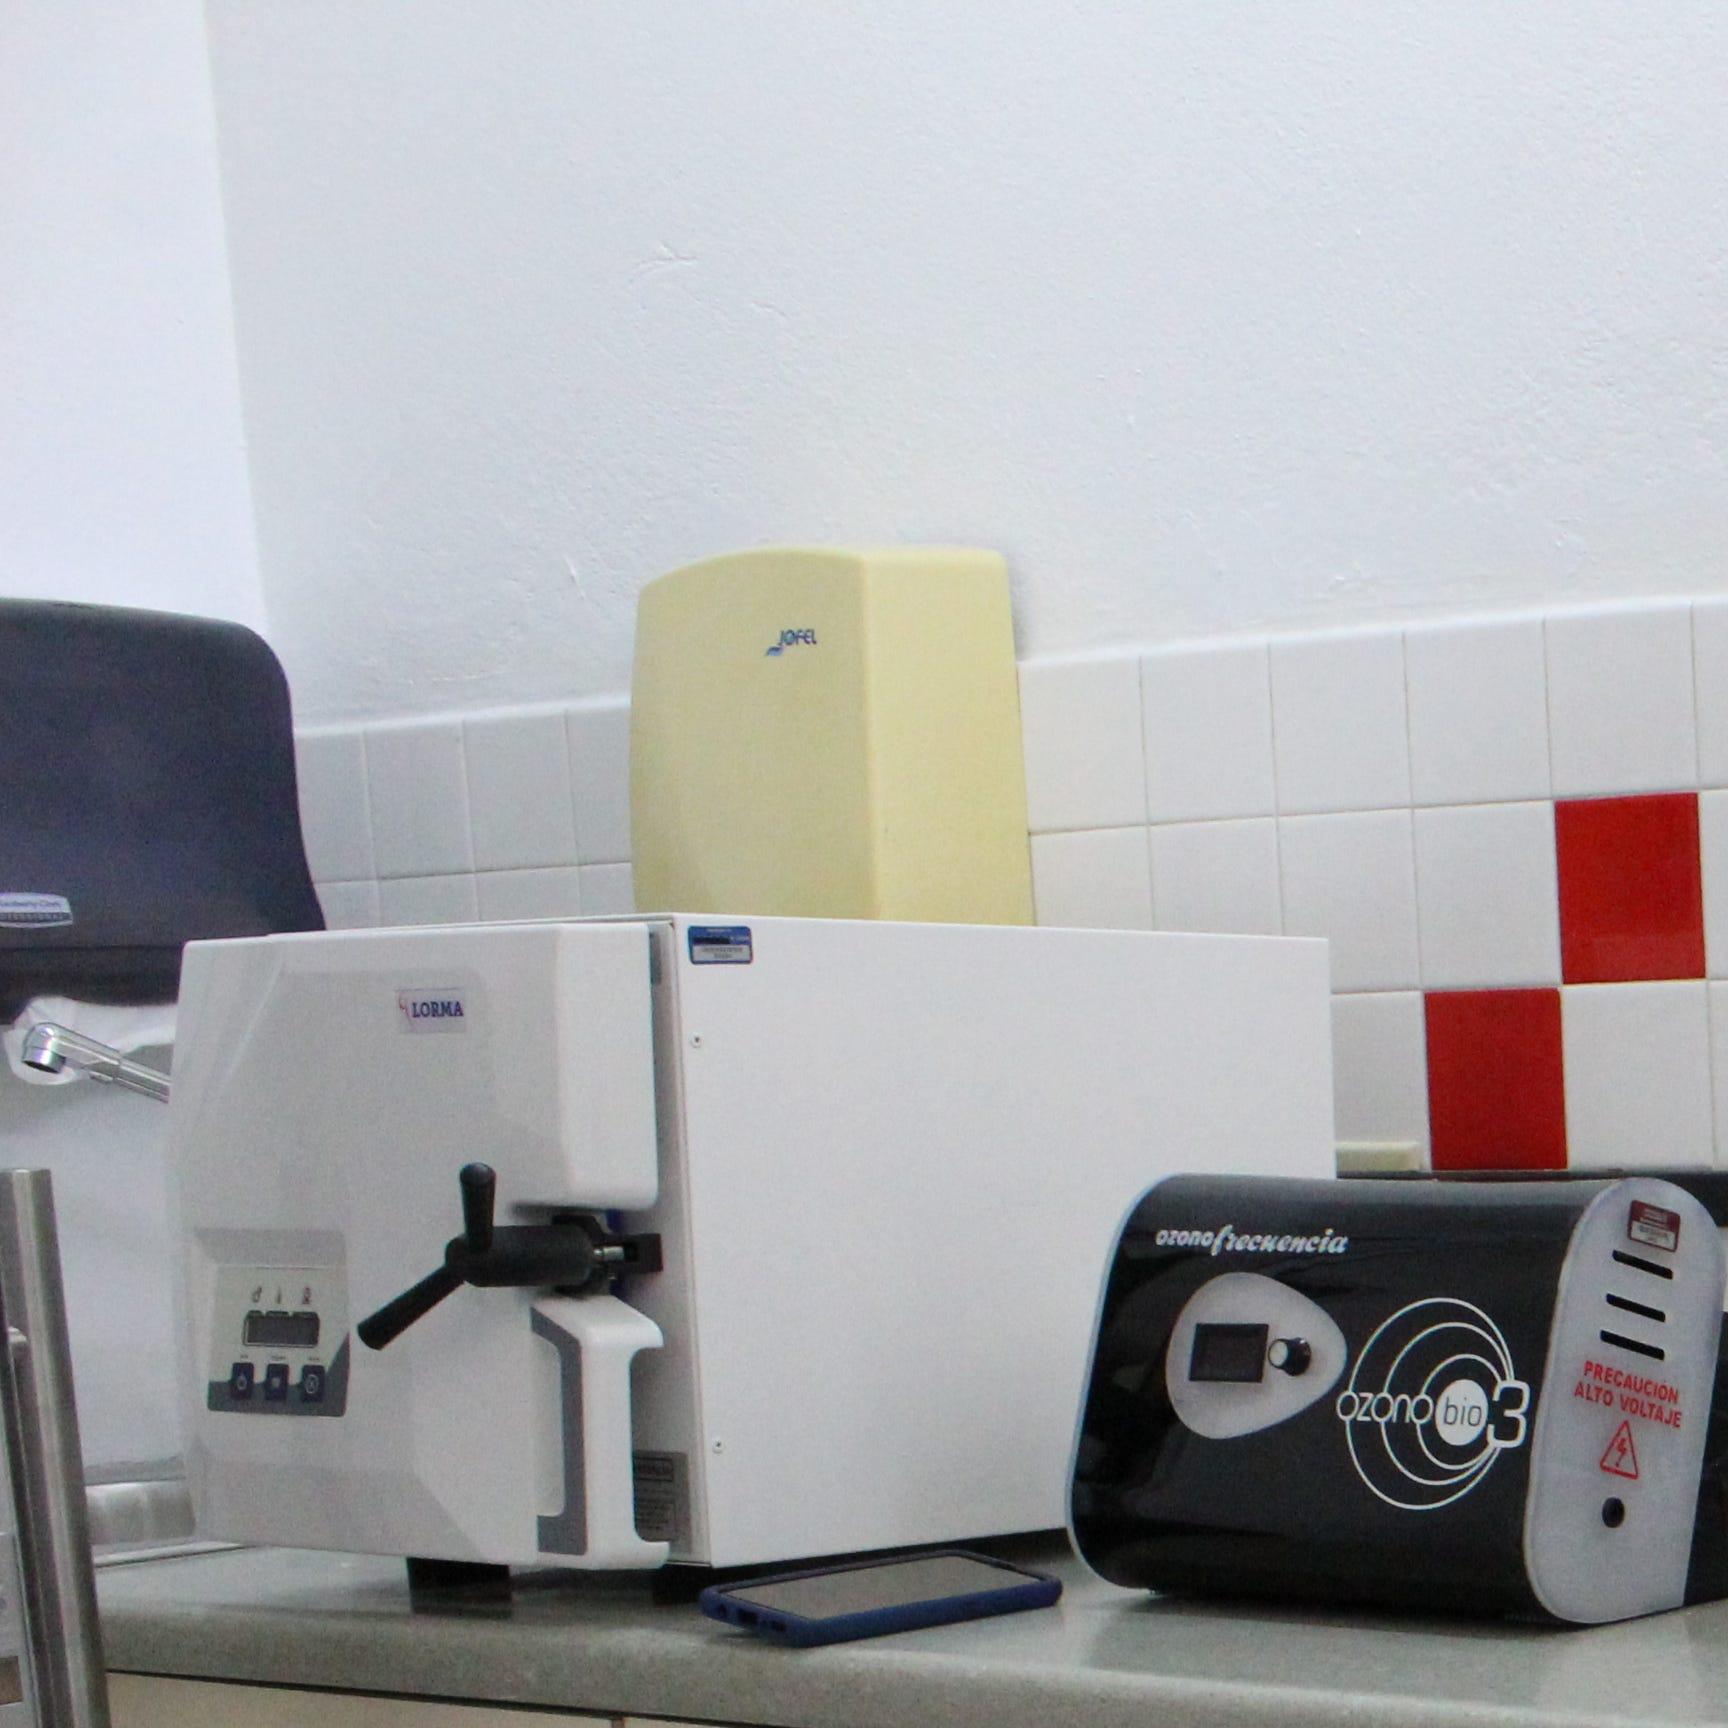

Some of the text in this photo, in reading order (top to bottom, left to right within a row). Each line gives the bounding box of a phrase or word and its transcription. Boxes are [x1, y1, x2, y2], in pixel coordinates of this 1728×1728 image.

[411, 1000, 465, 1018] LORMA
[1155, 1224, 1350, 1257] ozonofrecuencia
[1336, 1391, 1434, 1425] ozono
[1443, 1396, 1482, 1427] bio
[1574, 1381, 1683, 1429] ALTO VOLTAJE
